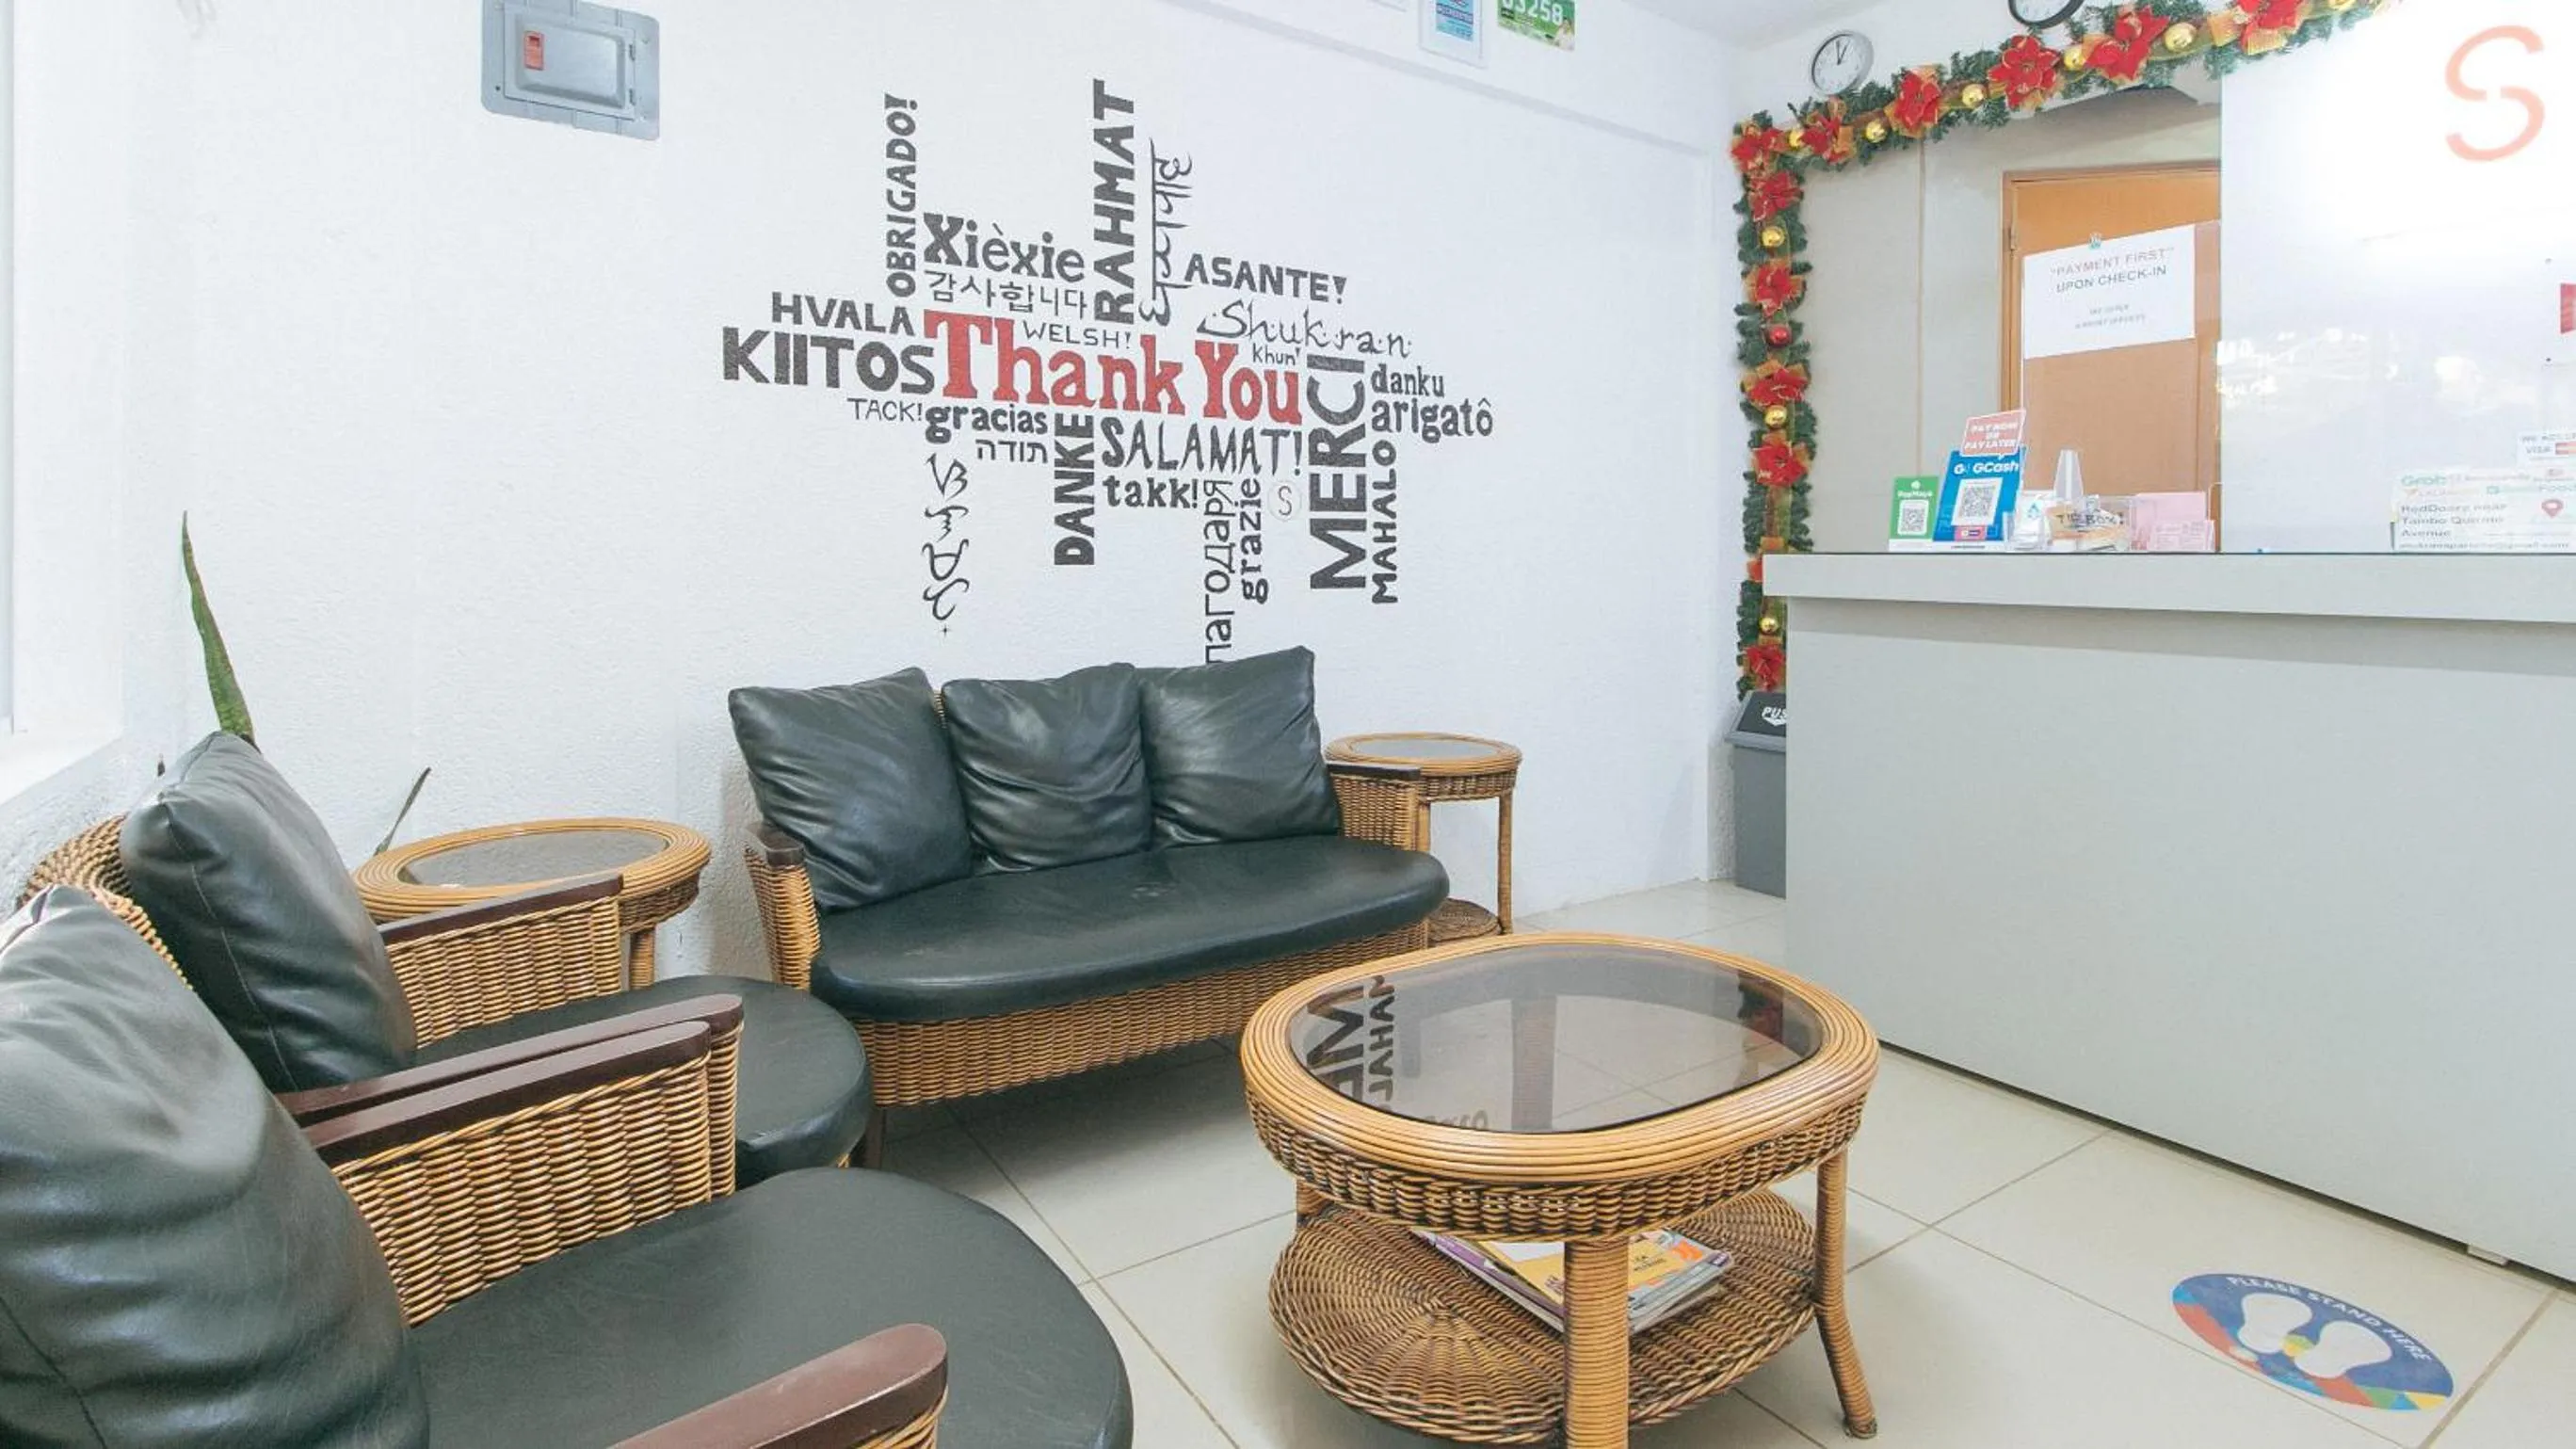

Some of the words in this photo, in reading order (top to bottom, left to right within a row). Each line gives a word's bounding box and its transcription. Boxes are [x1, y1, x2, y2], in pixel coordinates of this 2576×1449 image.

[884, 92, 918, 298] OBRIGADO!
[1093, 78, 1135, 325] RAHMAT
[923, 212, 1086, 282] Xièxie
[924, 269, 1087, 319] 감사합니다
[1184, 252, 1347, 304] ASANTE!
[2056, 278, 2095, 293] UPON
[2098, 265, 2166, 286] CHECK-IN
[771, 292, 915, 337] HVALA
[1023, 320, 1133, 350] WELSH!
[1197, 299, 1411, 360] Shukran
[722, 326, 936, 395] KIITOS
[923, 309, 1186, 416] Thank
[1195, 339, 1303, 426] You
[1370, 363, 1445, 397] danku
[847, 397, 923, 423] TACK!
[925, 403, 1048, 444] gracias
[1372, 397, 1493, 443] arigatô
[975, 439, 1048, 464] תודה
[1101, 416, 1302, 476] SALAMAT!
[1306, 353, 1367, 590] MERCI
[1972, 460, 2019, 475] GCash
[1054, 412, 1095, 566] DANKE
[1102, 475, 1199, 509] takk!
[1239, 477, 1269, 604] grazie
[1372, 439, 1398, 604] MAHALO
[1762, 706, 1787, 718] PUS
[2226, 1277, 2301, 1296] PLEASE
[2307, 1292, 2383, 1328] STAND
[2384, 1327, 2434, 1362] HERE
